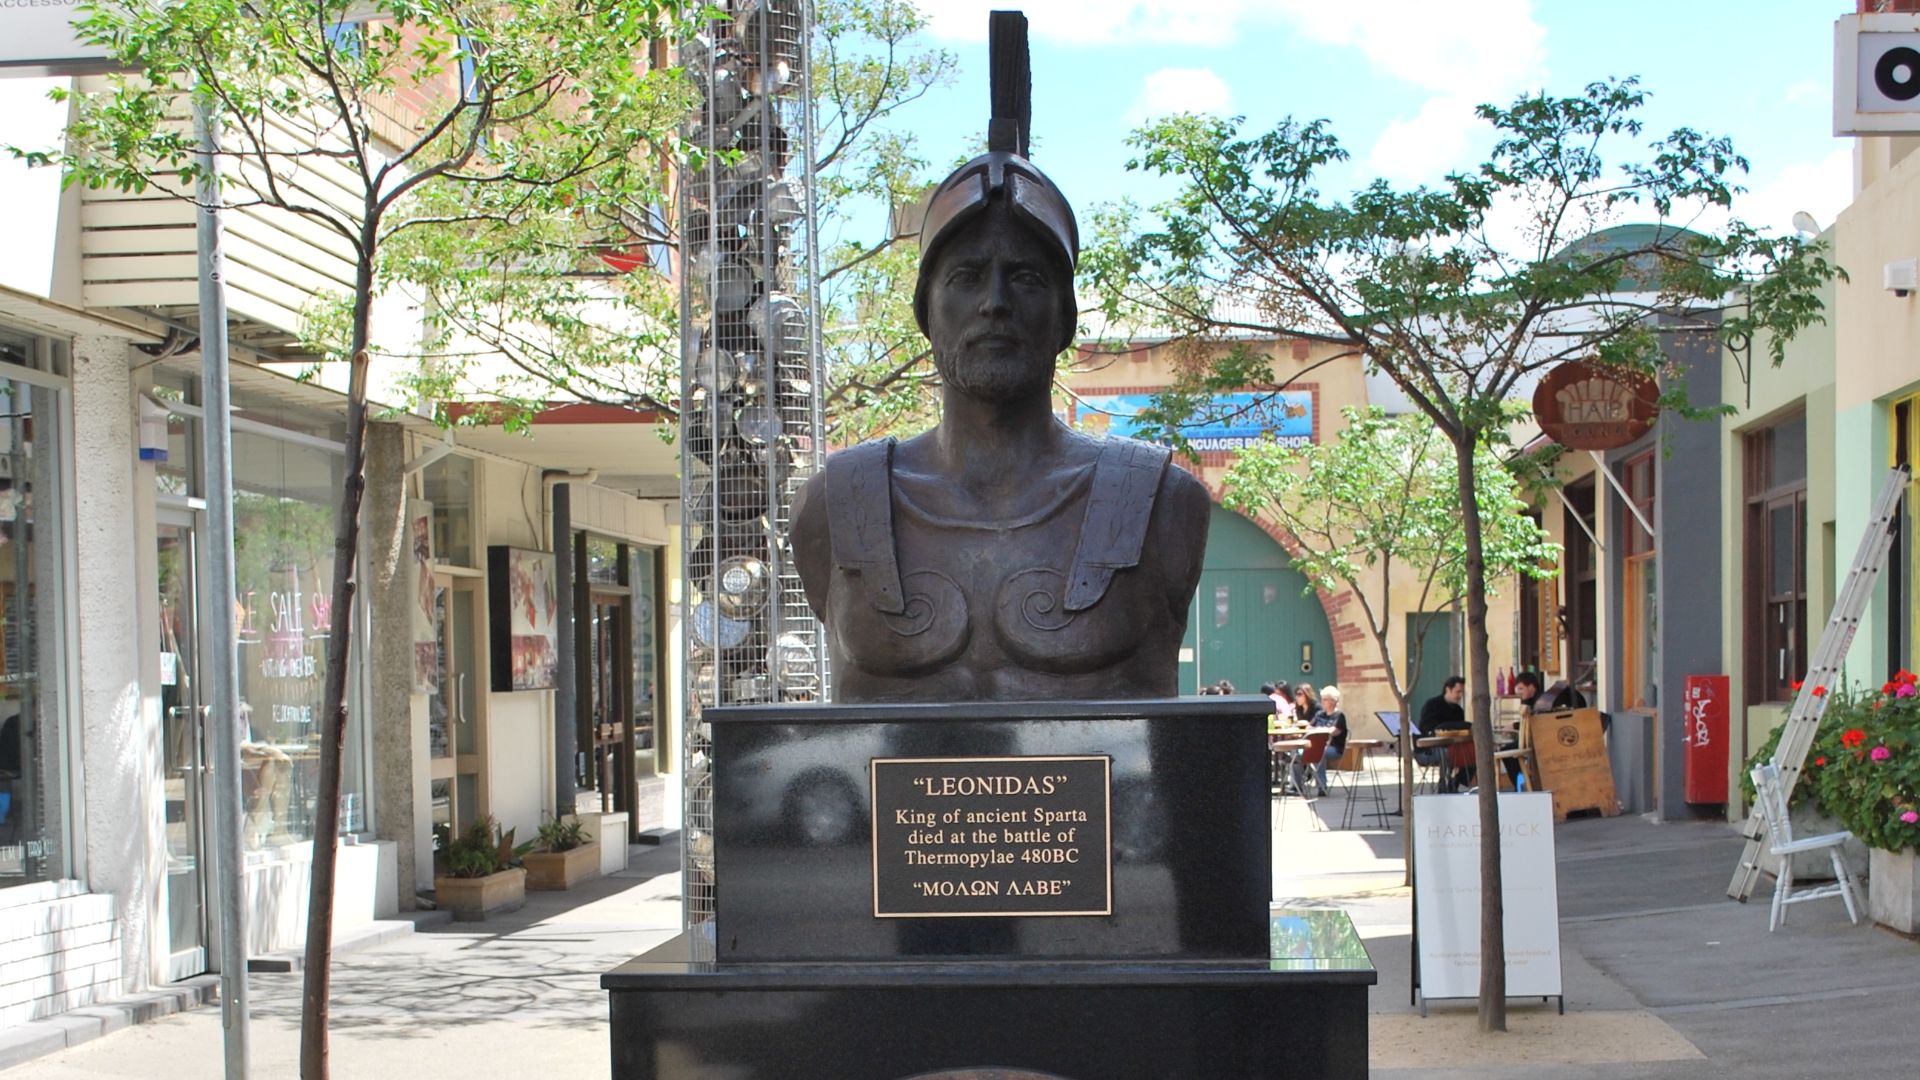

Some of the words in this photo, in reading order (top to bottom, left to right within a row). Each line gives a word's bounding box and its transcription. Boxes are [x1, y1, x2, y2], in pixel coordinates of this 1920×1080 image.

[1568, 402, 1623, 421] HAIR
[1172, 436, 1244, 451] LNGUAGES
[270, 591, 305, 634] SALE
[913, 775, 1068, 797] “LEONIDAS”
[895, 809, 936, 827] King
[943, 809, 961, 824] of
[966, 808, 1027, 823] ancient
[1033, 807, 1087, 825] Sparta
[908, 829, 943, 845] died
[950, 830, 966, 844] at
[972, 829, 998, 844] the
[1004, 828, 1051, 844] battle
[1057, 828, 1076, 843] of
[904, 849, 1014, 868] Thermopylae
[1021, 848, 1079, 864] 480BC
